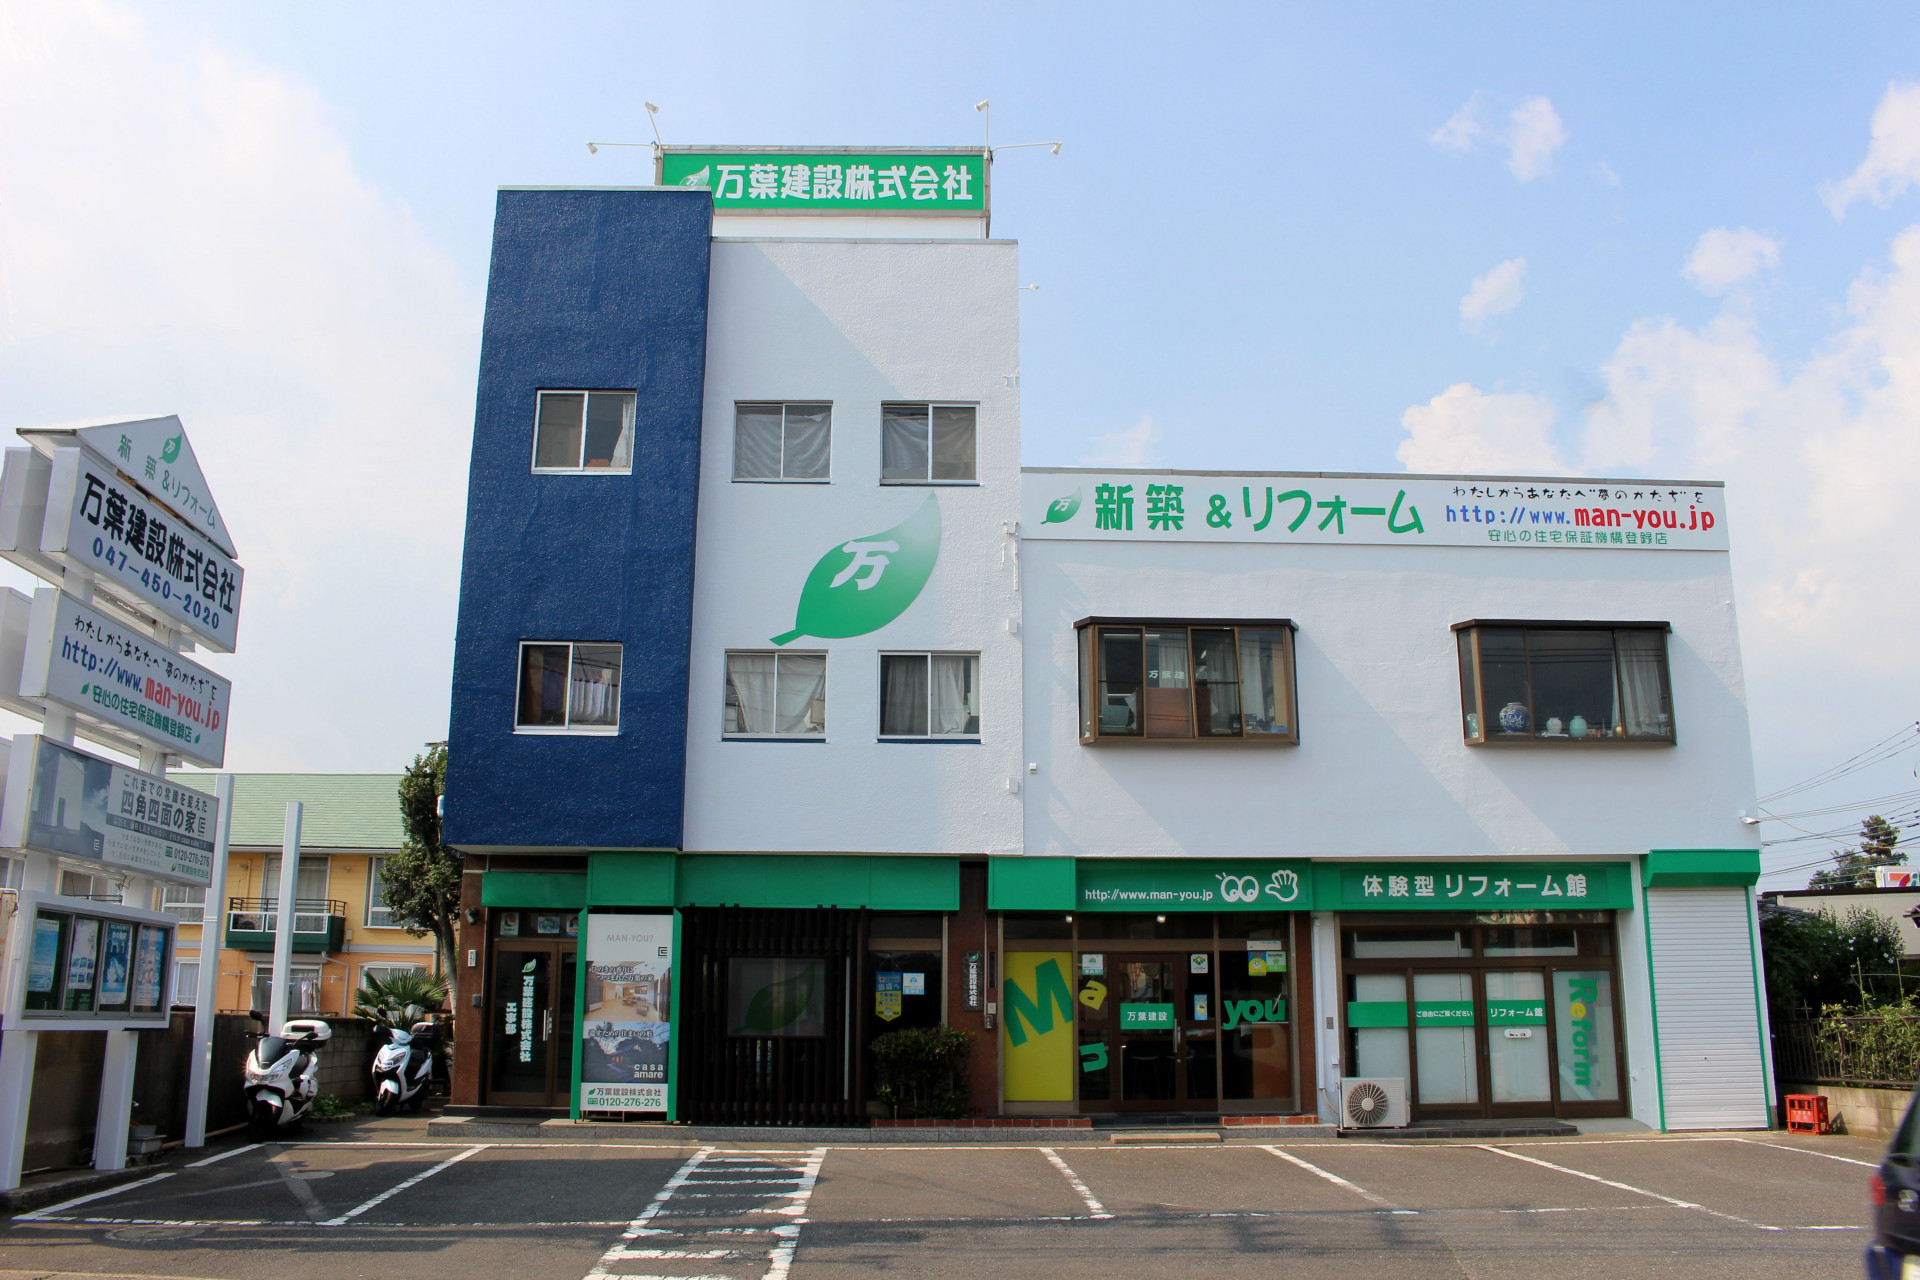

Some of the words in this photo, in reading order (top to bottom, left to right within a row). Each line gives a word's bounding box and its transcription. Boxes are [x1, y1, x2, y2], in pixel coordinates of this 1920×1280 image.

[716, 163, 973, 201] 万葉建設株式会社
[1446, 505, 1715, 532] http://www.man-you.jp
[1488, 529, 1668, 545] 安心の住宅保証機構登録店
[80, 472, 236, 615] 万葉建設株式会社
[93, 537, 220, 630] 047-450-2020
[62, 636, 220, 731] http://www.man-you.jp
[121, 790, 197, 834] 四角四面の家
[124, 774, 208, 813] これまでの常識を変えた
[1085, 889, 1213, 902] http://www.man-you.jp
[520, 975, 535, 1062] 万葉建設株式会社
[1127, 1011, 1168, 1021] 万葉建設
[1490, 1007, 1544, 1018] リフォーム館
[1567, 978, 1598, 1086] Reform
[597, 1088, 662, 1097] 万葉建設株式会社
[599, 1097, 661, 1107] 0120-276-276
